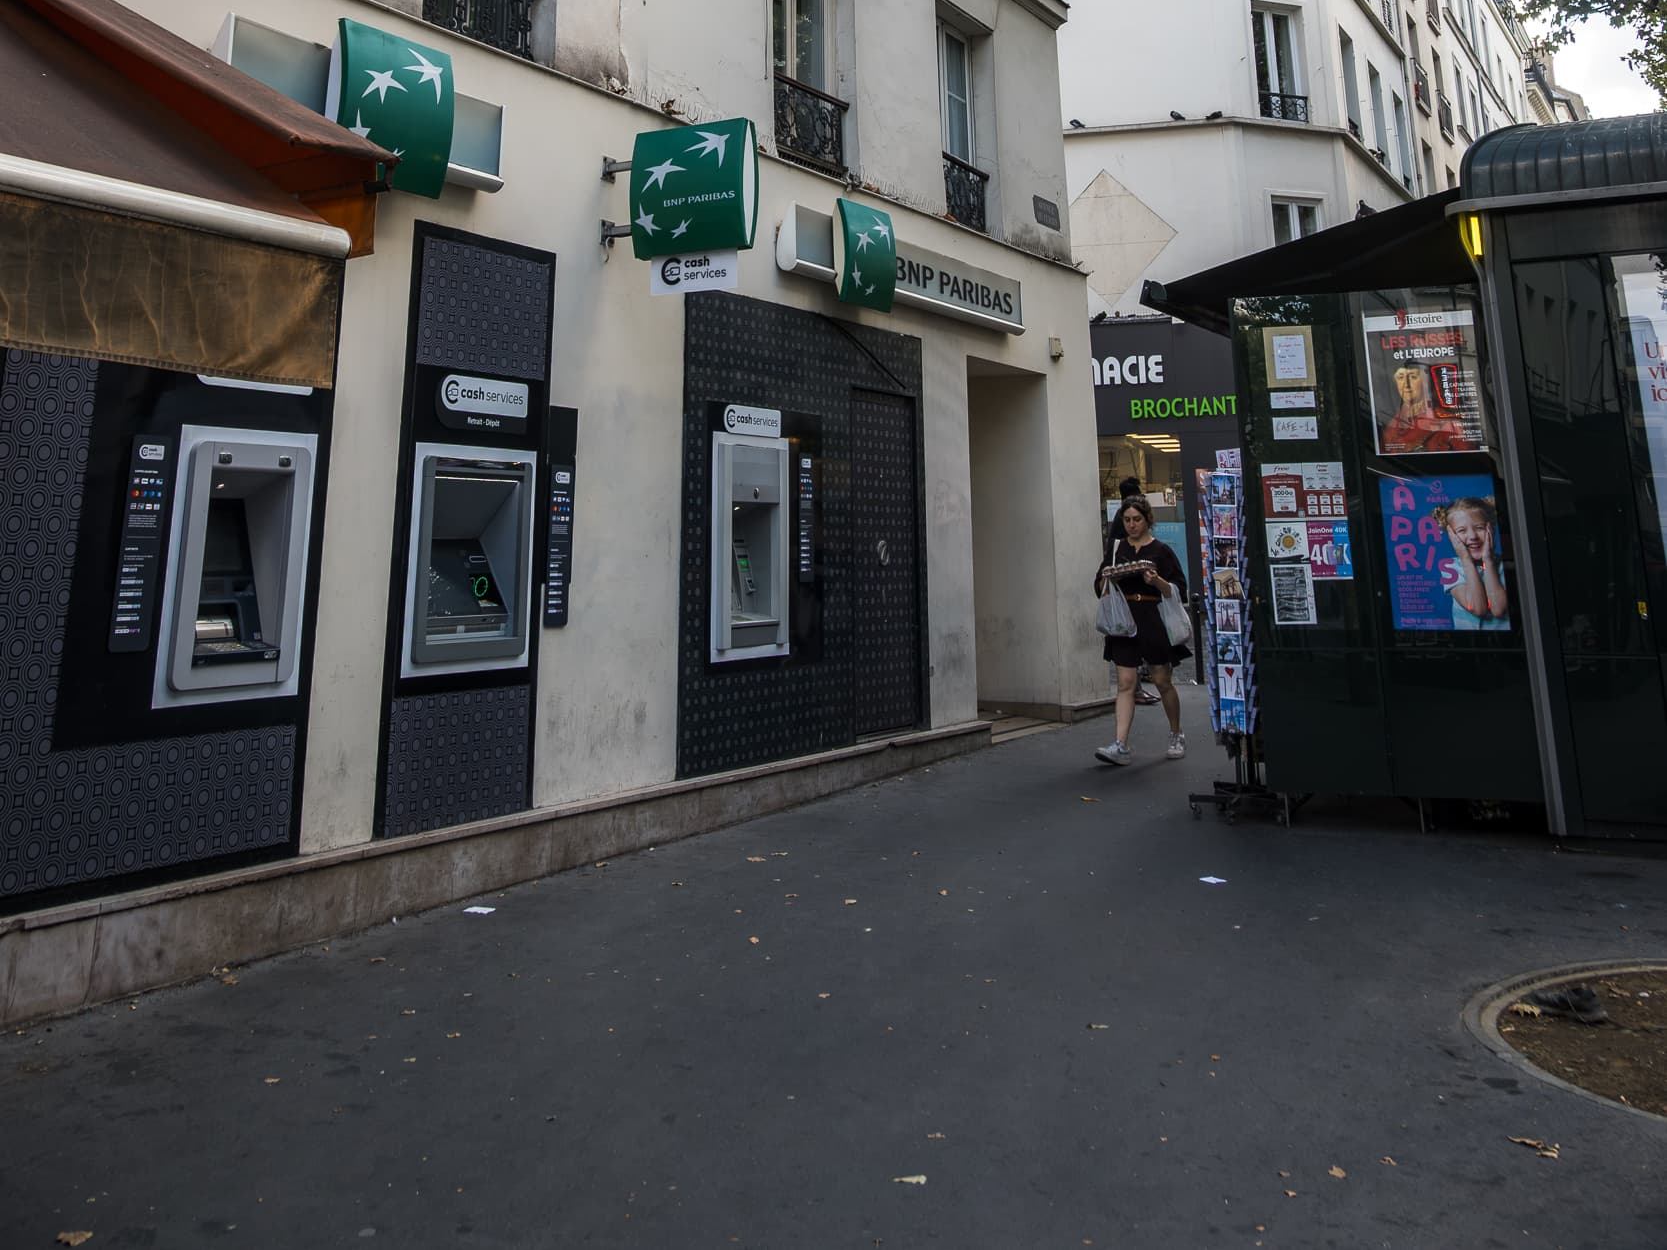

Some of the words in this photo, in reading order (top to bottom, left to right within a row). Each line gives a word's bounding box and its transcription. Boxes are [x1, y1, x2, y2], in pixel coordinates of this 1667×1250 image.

[663, 197, 685, 207] BNP
[688, 190, 736, 204] PARIBAS
[684, 255, 710, 268] cash
[684, 268, 727, 280] services
[896, 256, 934, 288] BNP
[940, 270, 1013, 315] PARIBAS
[1381, 335, 1407, 349] LES
[1410, 331, 1463, 347] RUSSES
[1393, 350, 1403, 359] et
[1405, 347, 1455, 359] L'EUROPE
[1648, 363, 1667, 380] vi
[461, 387, 484, 400] cash
[486, 391, 524, 405] services
[1130, 395, 1237, 419] BROCHANT
[737, 414, 752, 424] cash
[753, 416, 778, 427] services
